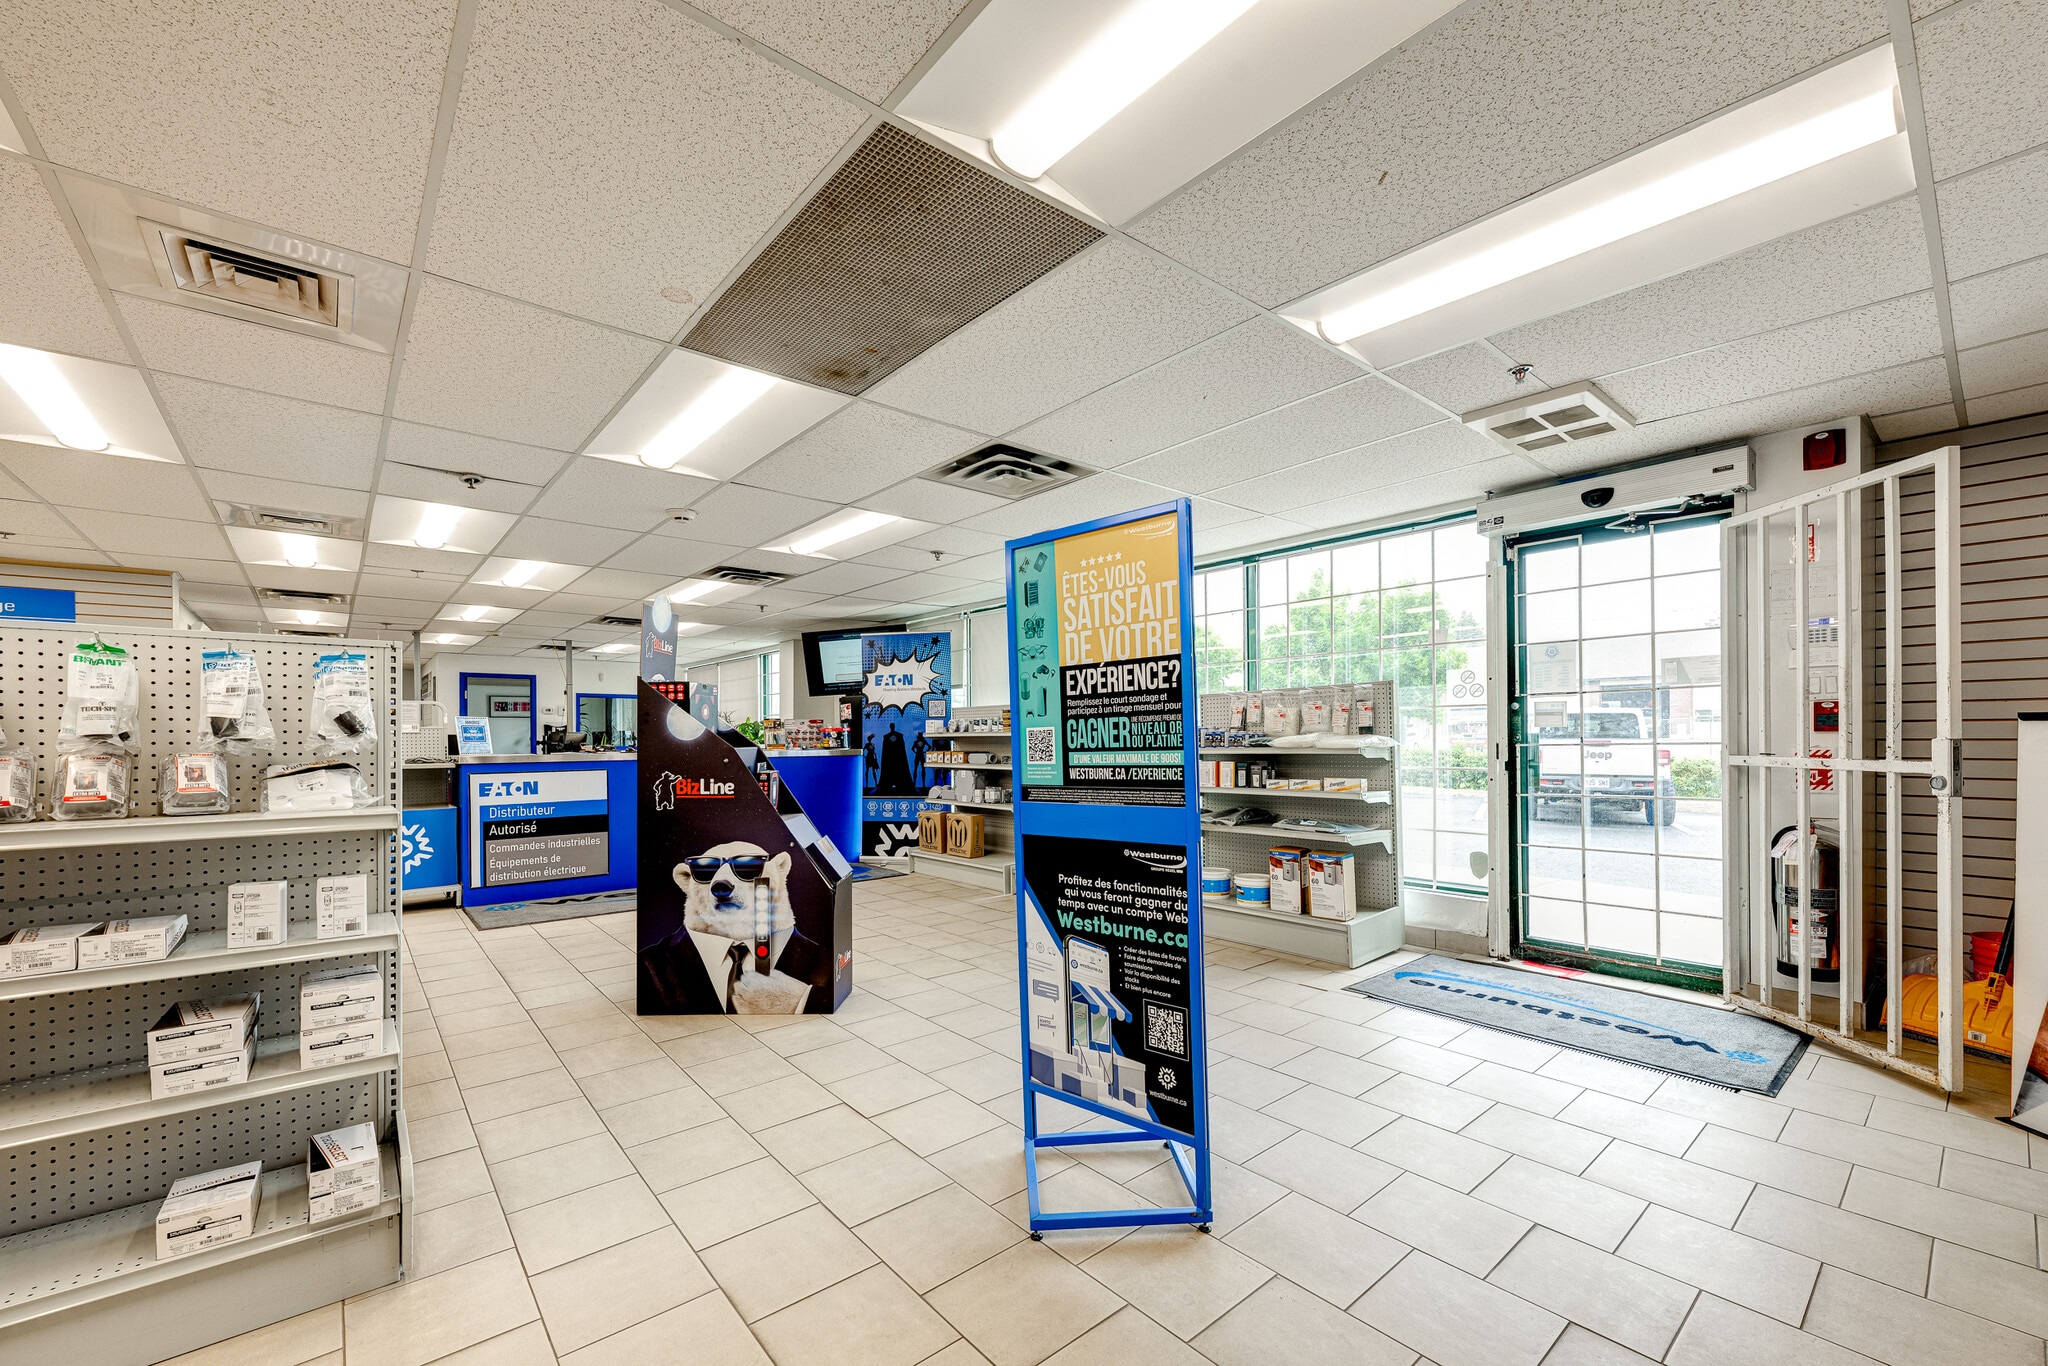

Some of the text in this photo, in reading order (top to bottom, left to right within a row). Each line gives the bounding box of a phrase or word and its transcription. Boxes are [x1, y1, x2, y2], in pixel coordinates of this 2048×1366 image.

[1062, 560, 1147, 598] ÊTES-VOUS
[1063, 580, 1178, 632] SATISFAIT
[1065, 618, 1178, 666] DE VOTRE
[73, 655, 122, 666] BRYANT
[875, 674, 913, 687] EATON
[1066, 660, 1180, 696] EXPÉRIENCE?
[1067, 693, 1168, 707] Remplissez le court sondage et
[1067, 706, 1098, 717] participez
[1098, 705, 1102, 714] à
[1113, 704, 1132, 714] tirage
[1133, 702, 1164, 711] mensuel
[1165, 702, 1182, 710] pour
[1067, 716, 1131, 749] GAGNER
[1131, 721, 1182, 735] NIVEAU OR
[1132, 734, 1183, 748] OU PLATINE
[1074, 753, 1181, 764] D'UNE VALEUR MAXIMALE DE 900$!
[1584, 750, 1612, 760] Jeep
[1069, 767, 1126, 780] WESTBURNE.CA
[1127, 767, 1183, 780] /EXPERIENCE
[479, 781, 538, 797] EATON
[676, 778, 735, 795] BizLine
[489, 806, 555, 819] Distributeur
[489, 821, 537, 836] Autorisé
[489, 837, 601, 853] Commandes industrielles
[489, 854, 561, 870] Équipements de
[1129, 850, 1183, 861] Westburne
[489, 865, 586, 882] distribution électrique
[1058, 873, 1188, 898] Profitez des fonctionnalités
[1065, 887, 1188, 911] qui vous feront gagner du
[1058, 897, 1188, 924] temps avec un compte Web
[1057, 909, 1188, 948] Westburne.ca
[1124, 946, 1137, 954] Créer
[1148, 950, 1160, 958] listes
[1169, 953, 1187, 963] favoris
[1124, 953, 1136, 961] Faire
[1147, 958, 1173, 968] demandes
[1124, 962, 1153, 971] soumissions
[1125, 976, 1139, 984] stocks
[1140, 971, 1170, 983] disponibilité
[1170, 977, 1180, 985] des
[1153, 990, 1171, 998] encore
[1409, 979, 1720, 1054] Westburne
